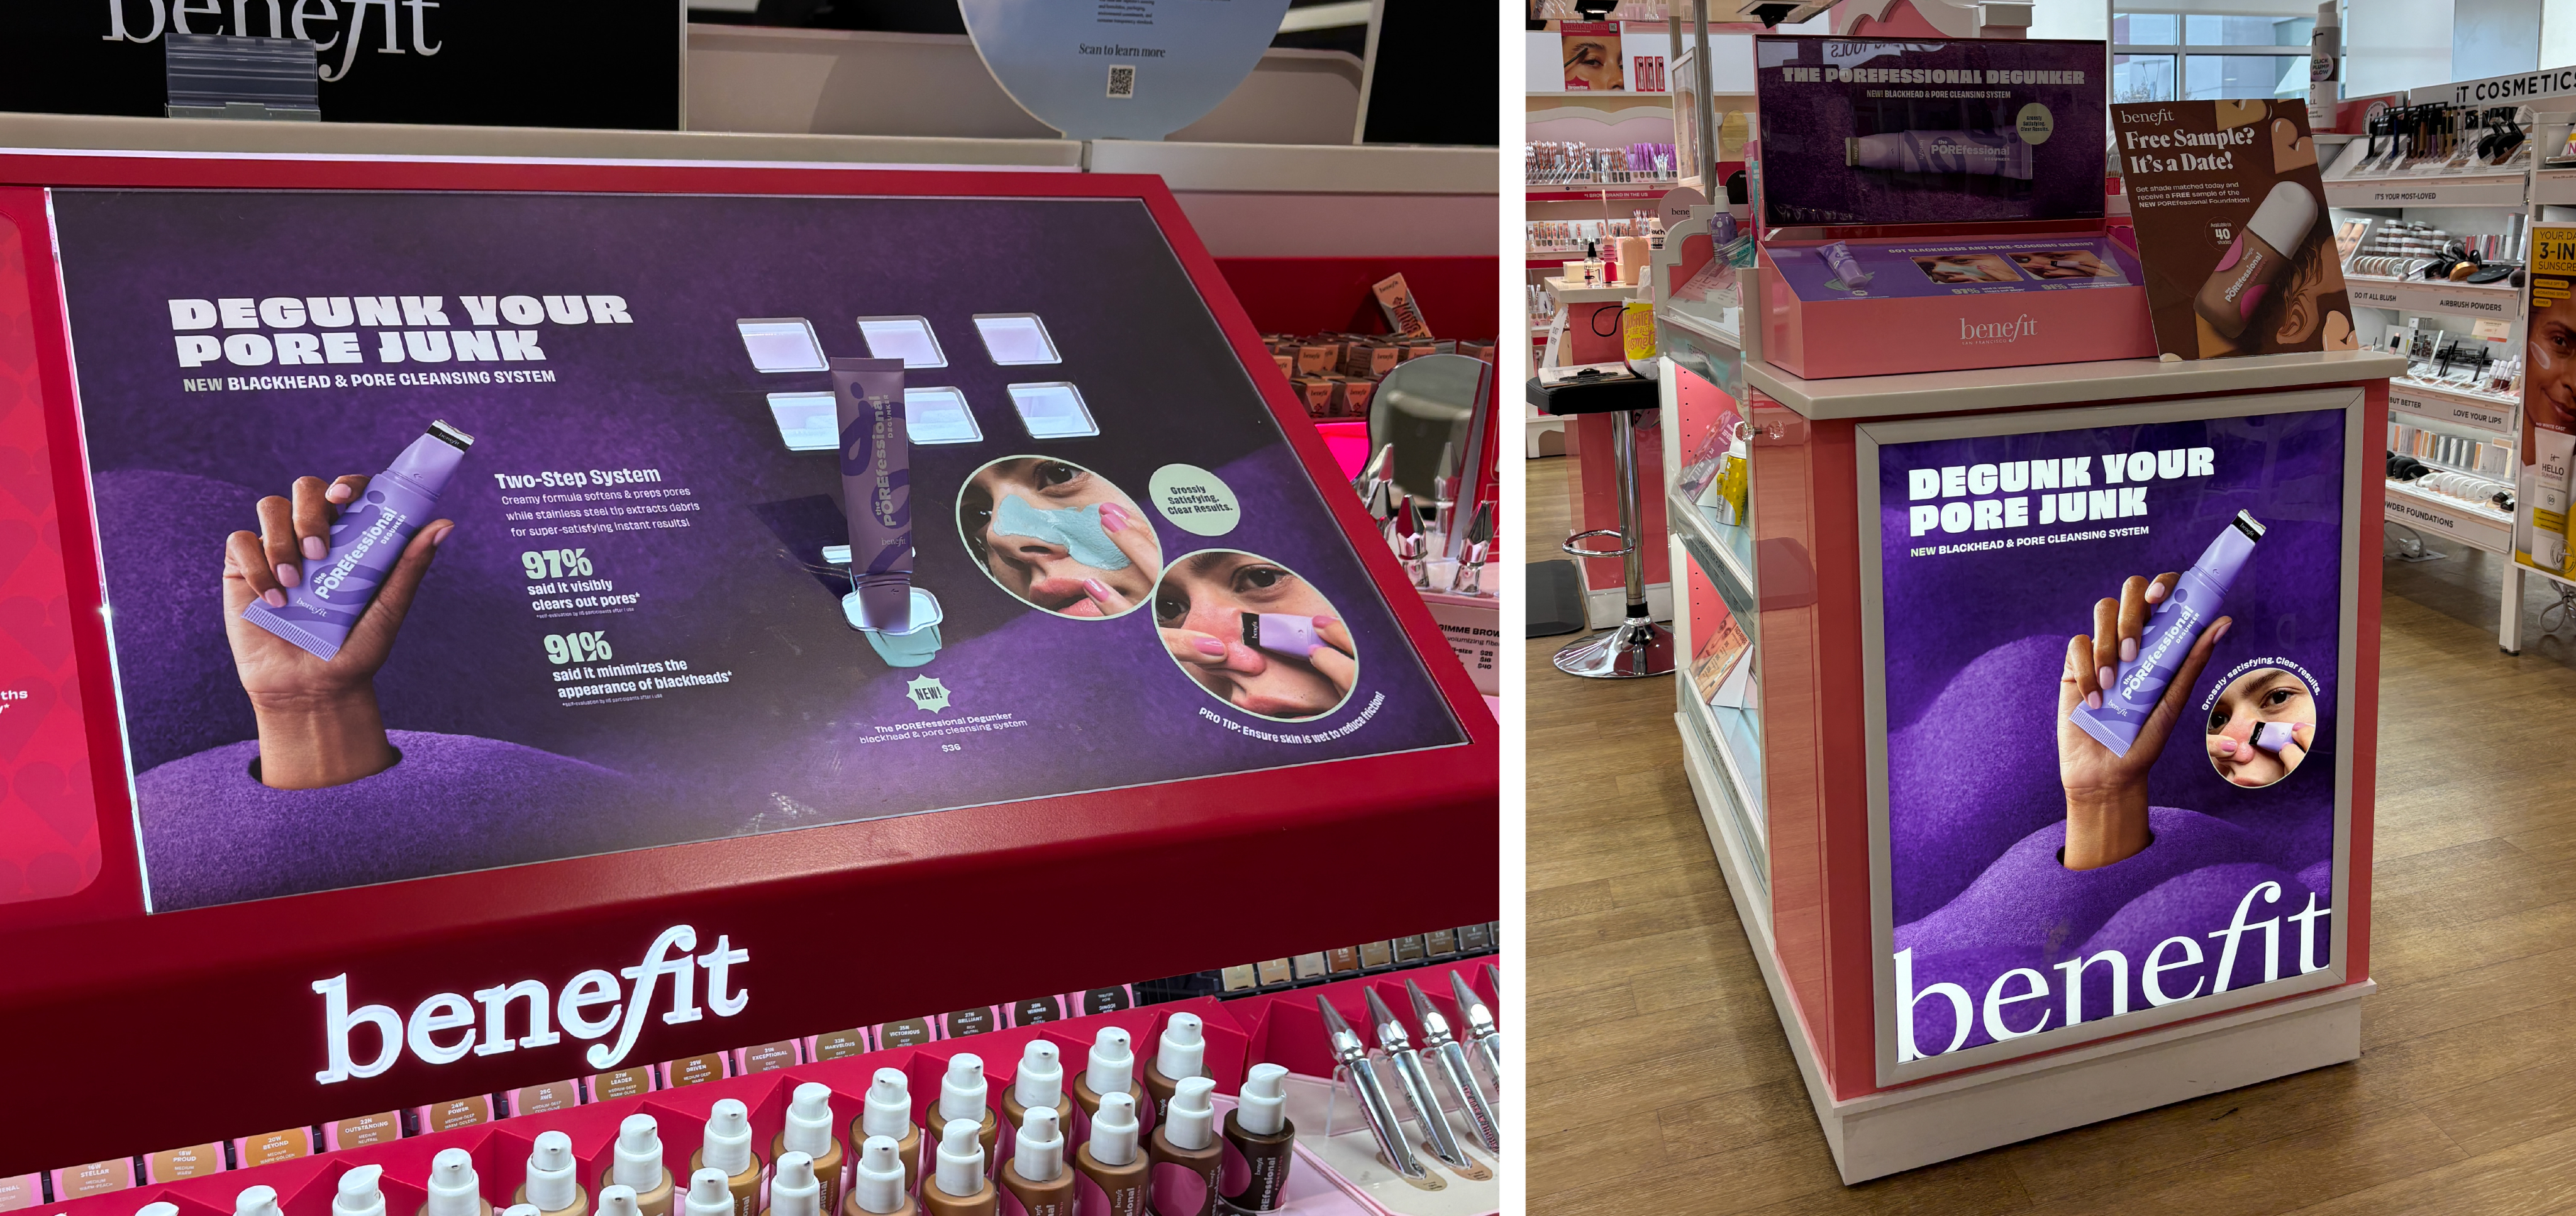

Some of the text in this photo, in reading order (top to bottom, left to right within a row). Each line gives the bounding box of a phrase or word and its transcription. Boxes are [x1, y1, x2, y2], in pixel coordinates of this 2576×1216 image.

[1079, 43, 1165, 57] Scan to learn more
[1783, 68, 2085, 84] THE POREFESSIONAL DEGUNKER
[2120, 109, 2174, 126] benefit
[2125, 127, 2255, 149] Free Sample?
[2166, 159, 2179, 171] a
[2180, 151, 2233, 170] Date!
[2215, 228, 2230, 239] 40
[168, 295, 633, 330] DEGUNK YOUR
[2440, 299, 2502, 311] AIRBRUSH POWDERS
[1960, 313, 2038, 342] benefit
[175, 331, 547, 367] PORE JUNK
[184, 370, 556, 392] NEW BLACKHEAD & PORE CLEANSING SYSTEM
[2401, 399, 2421, 408] BETTER
[2453, 410, 2468, 418] LOVE
[2470, 412, 2487, 421] YOUR
[869, 396, 897, 527] POREfessional
[2542, 463, 2564, 475] HELLO
[494, 469, 661, 489] Two-Step System
[1909, 447, 2214, 500] DEGUNK YOUR
[2541, 472, 2563, 481] SUNSHINE
[502, 488, 691, 505] Creamy formula softens & preps pores
[506, 502, 700, 521] while stainless steel tip extracts debris
[1910, 487, 2148, 537] PORE JUNK
[2406, 508, 2453, 528] FOUNDATIONS
[511, 518, 691, 537] for super-satisfying instant results!
[314, 506, 397, 600] POREfessional
[521, 548, 593, 579] 97%
[527, 579, 613, 595] said it visibly
[532, 598, 573, 611] clears
[575, 596, 598, 608] out
[544, 630, 613, 664] 91%
[1447, 637, 1484, 645] volumizing
[2122, 605, 2194, 700] POREfessional
[553, 659, 687, 682] said it minimizes the
[558, 681, 636, 699] appearance
[638, 678, 652, 690] of
[2202, 657, 2321, 710] Grossly satisfying. Clear results.
[914, 687, 943, 701] NEW!
[875, 713, 1012, 733] The POREfessional Degunker
[1199, 691, 1385, 744] PRO TIP: Ensure skin is wet to reduce friction!
[860, 732, 910, 744] blackhead
[922, 728, 944, 738] pore
[945, 724, 992, 735] cleansing
[993, 720, 1028, 730] system
[941, 743, 961, 752] $36
[1893, 881, 2330, 1063] benefit
[312, 924, 750, 1085] benefit
[958, 1015, 982, 1024] BRILLIANT
[889, 1029, 920, 1037] VICTORIOUS
[824, 1041, 855, 1050] MARVELOUS
[752, 1051, 787, 1060] EXCEPTIONAL
[686, 1064, 706, 1073] DRIVEN
[448, 1107, 469, 1115] POWER
[345, 1121, 389, 1133] OUTSTANDING
[263, 1140, 289, 1149] BEYOND
[80, 1169, 109, 1177] STELLAR
